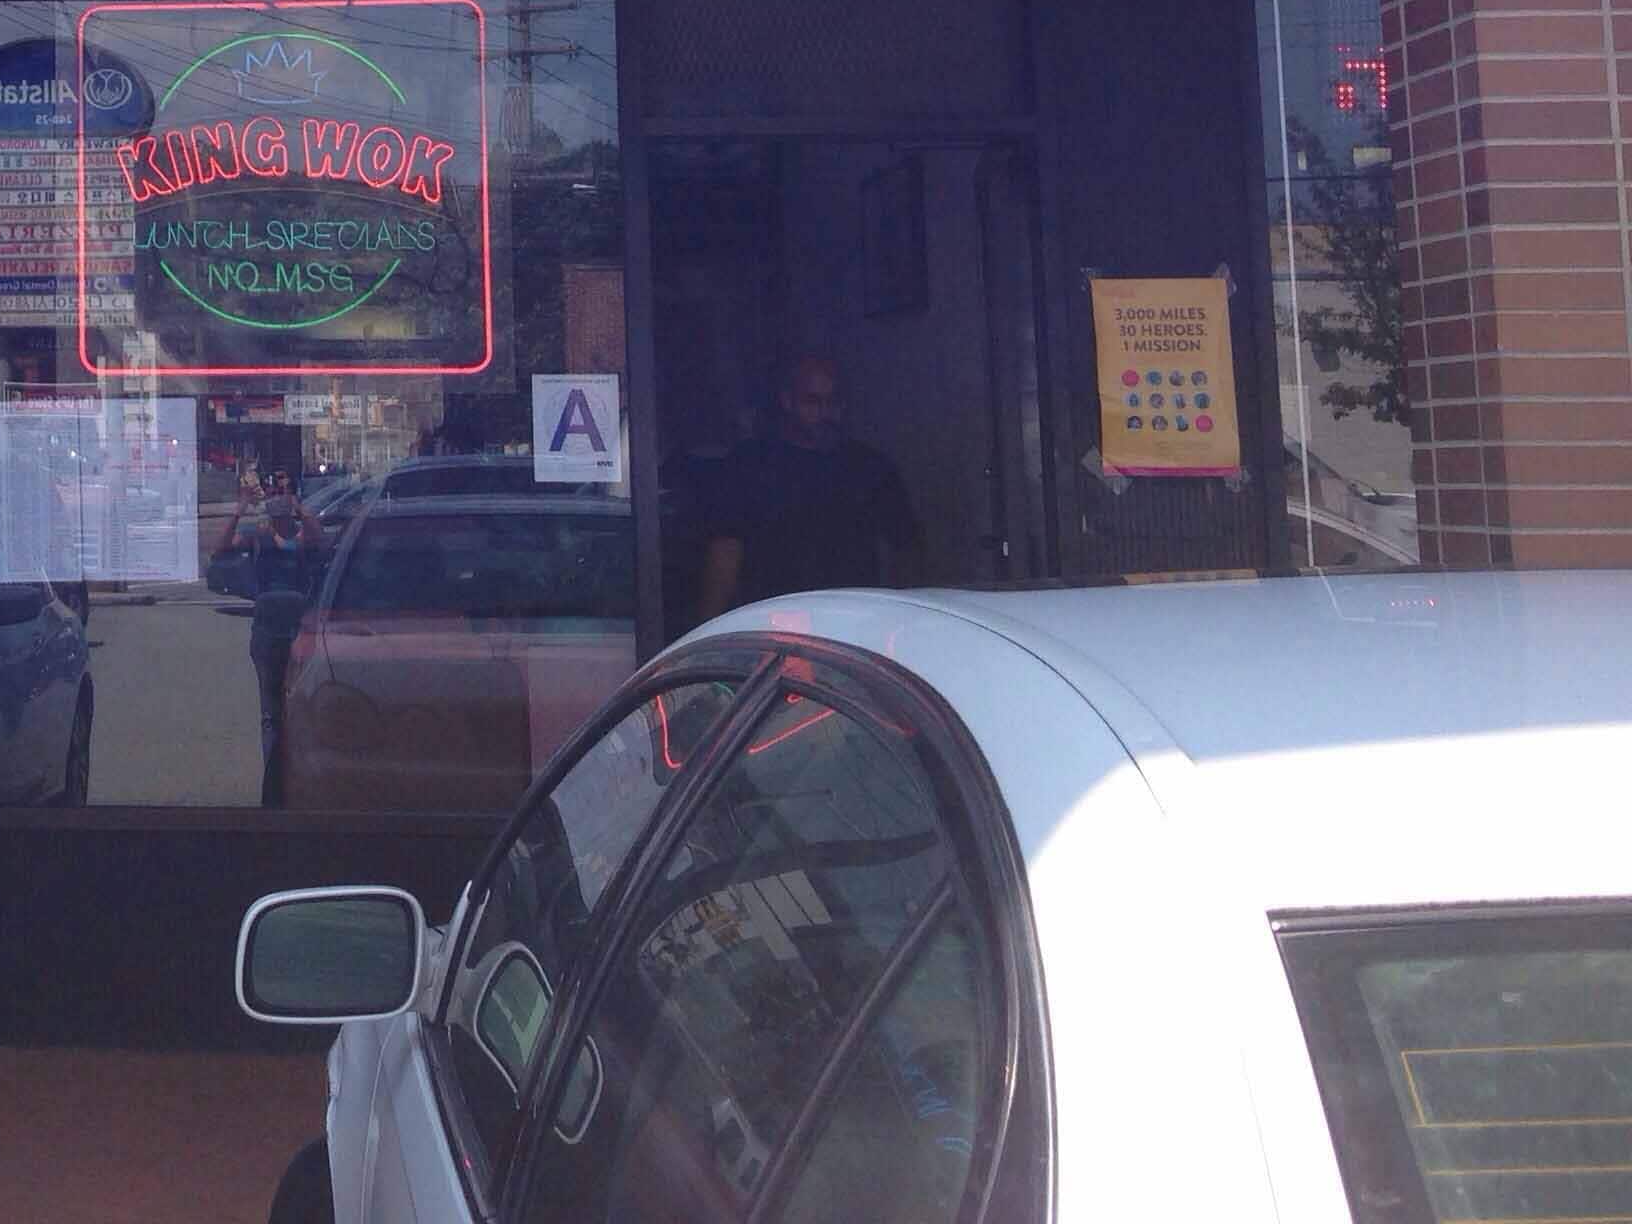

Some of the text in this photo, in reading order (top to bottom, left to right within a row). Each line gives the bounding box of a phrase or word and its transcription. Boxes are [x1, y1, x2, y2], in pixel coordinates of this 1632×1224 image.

[117, 116, 454, 204] KING WOK
[134, 221, 436, 251] LUNCH SPECIALS
[208, 261, 353, 293] NO MSG
[1115, 307, 1156, 322] 3,000
[549, 388, 607, 452] A
